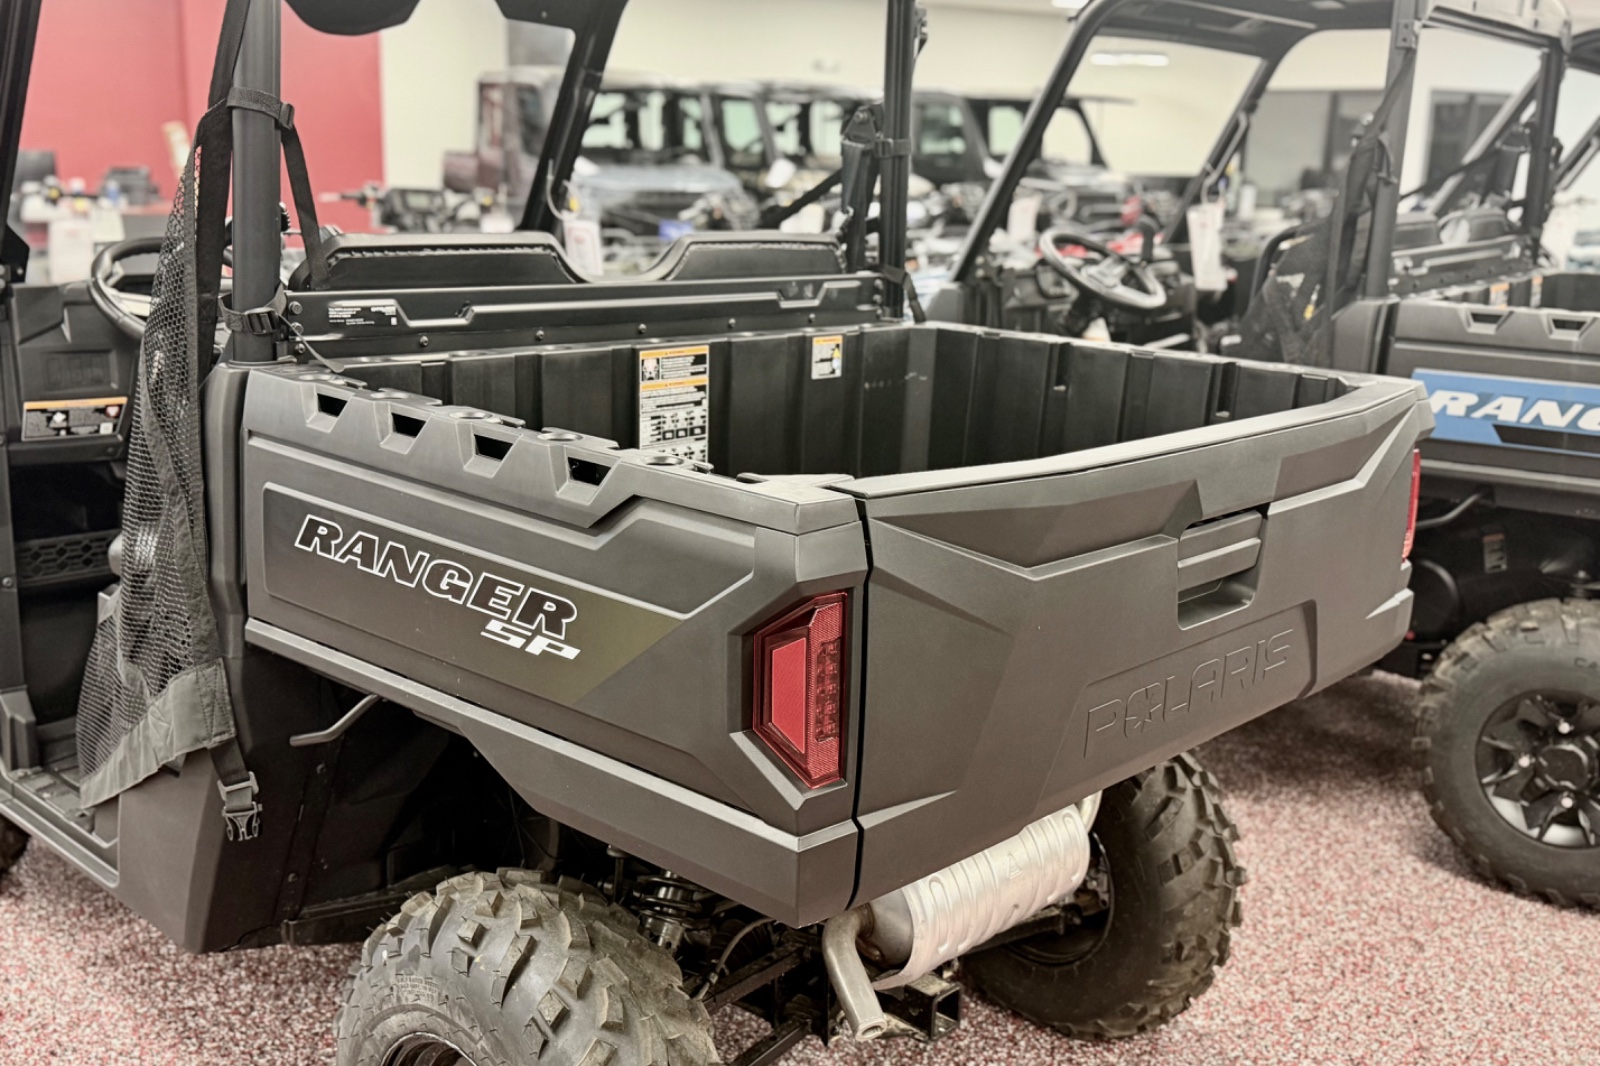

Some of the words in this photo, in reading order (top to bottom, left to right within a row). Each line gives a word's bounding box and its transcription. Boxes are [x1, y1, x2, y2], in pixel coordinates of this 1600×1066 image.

[294, 514, 578, 640] RANGER
[480, 619, 581, 660] SP
[1083, 628, 1294, 758] POLARIS
